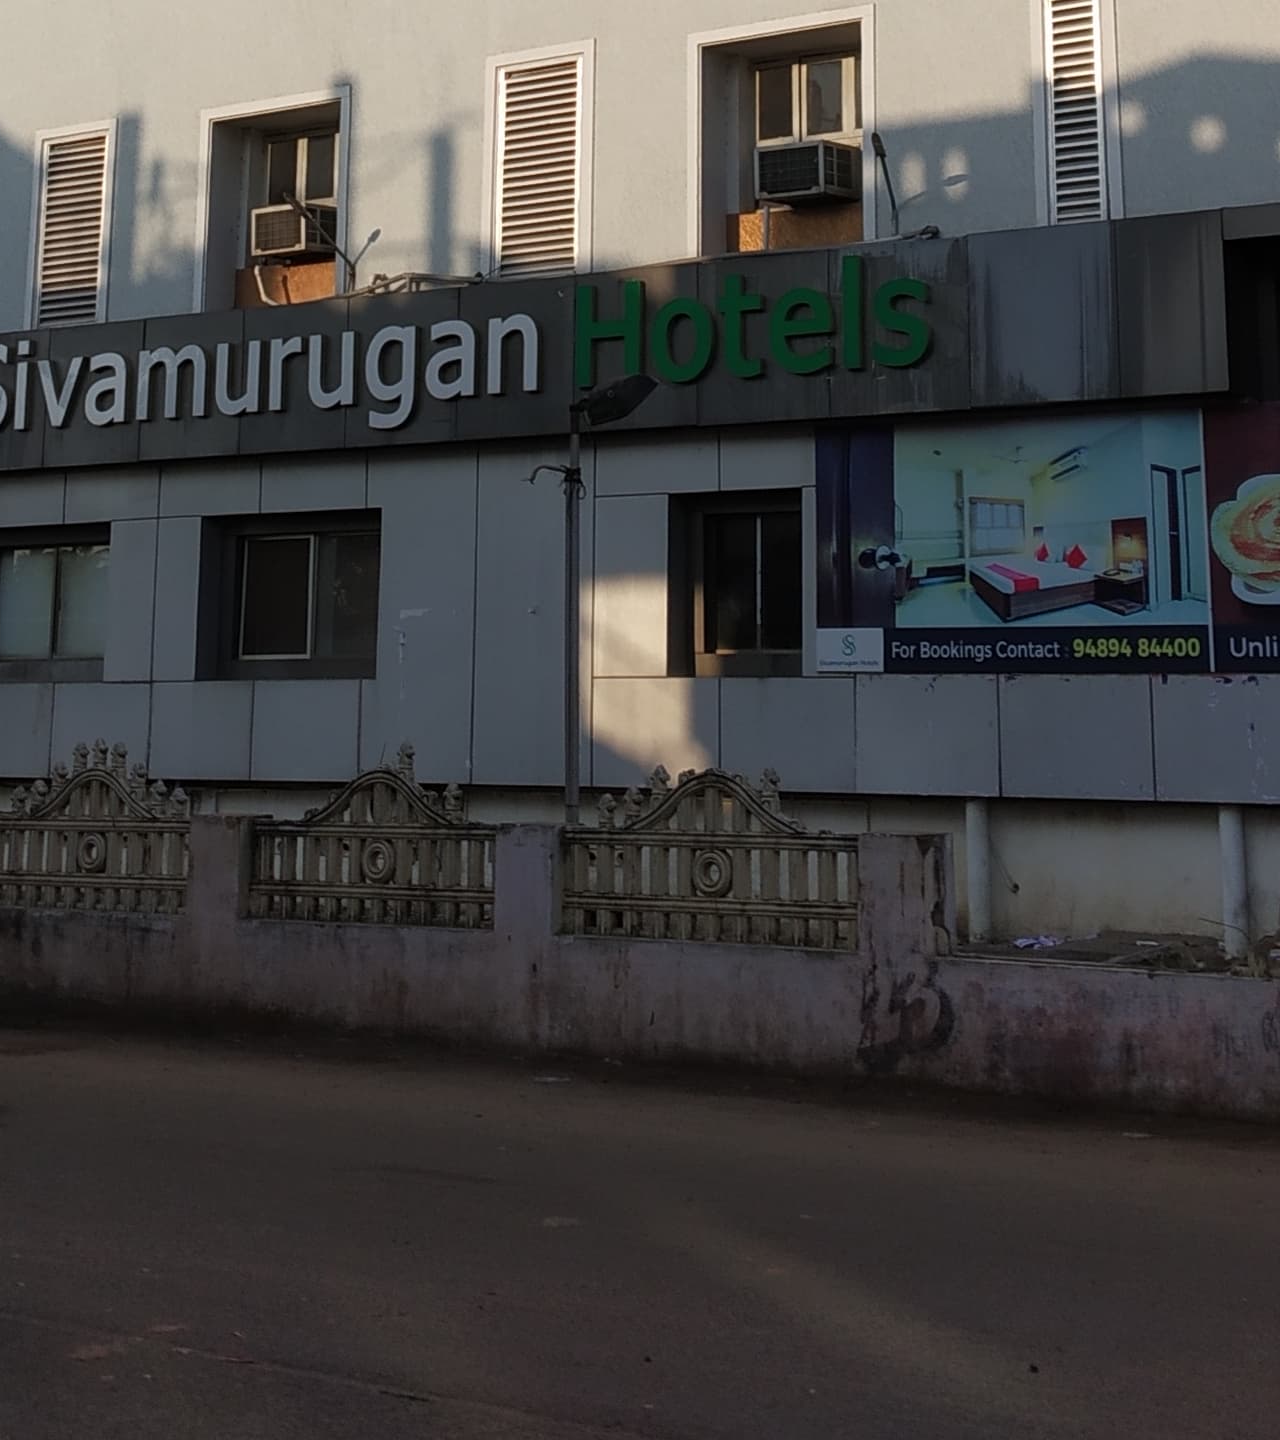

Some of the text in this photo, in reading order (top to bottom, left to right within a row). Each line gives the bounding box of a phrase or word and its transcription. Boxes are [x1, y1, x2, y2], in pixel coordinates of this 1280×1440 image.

[575, 255, 932, 389] Hotels
[891, 640, 917, 659] For
[919, 641, 993, 663] Bookings
[996, 640, 1061, 659] Contact
[1072, 637, 1132, 659] 94894
[1136, 637, 1201, 658] 84400
